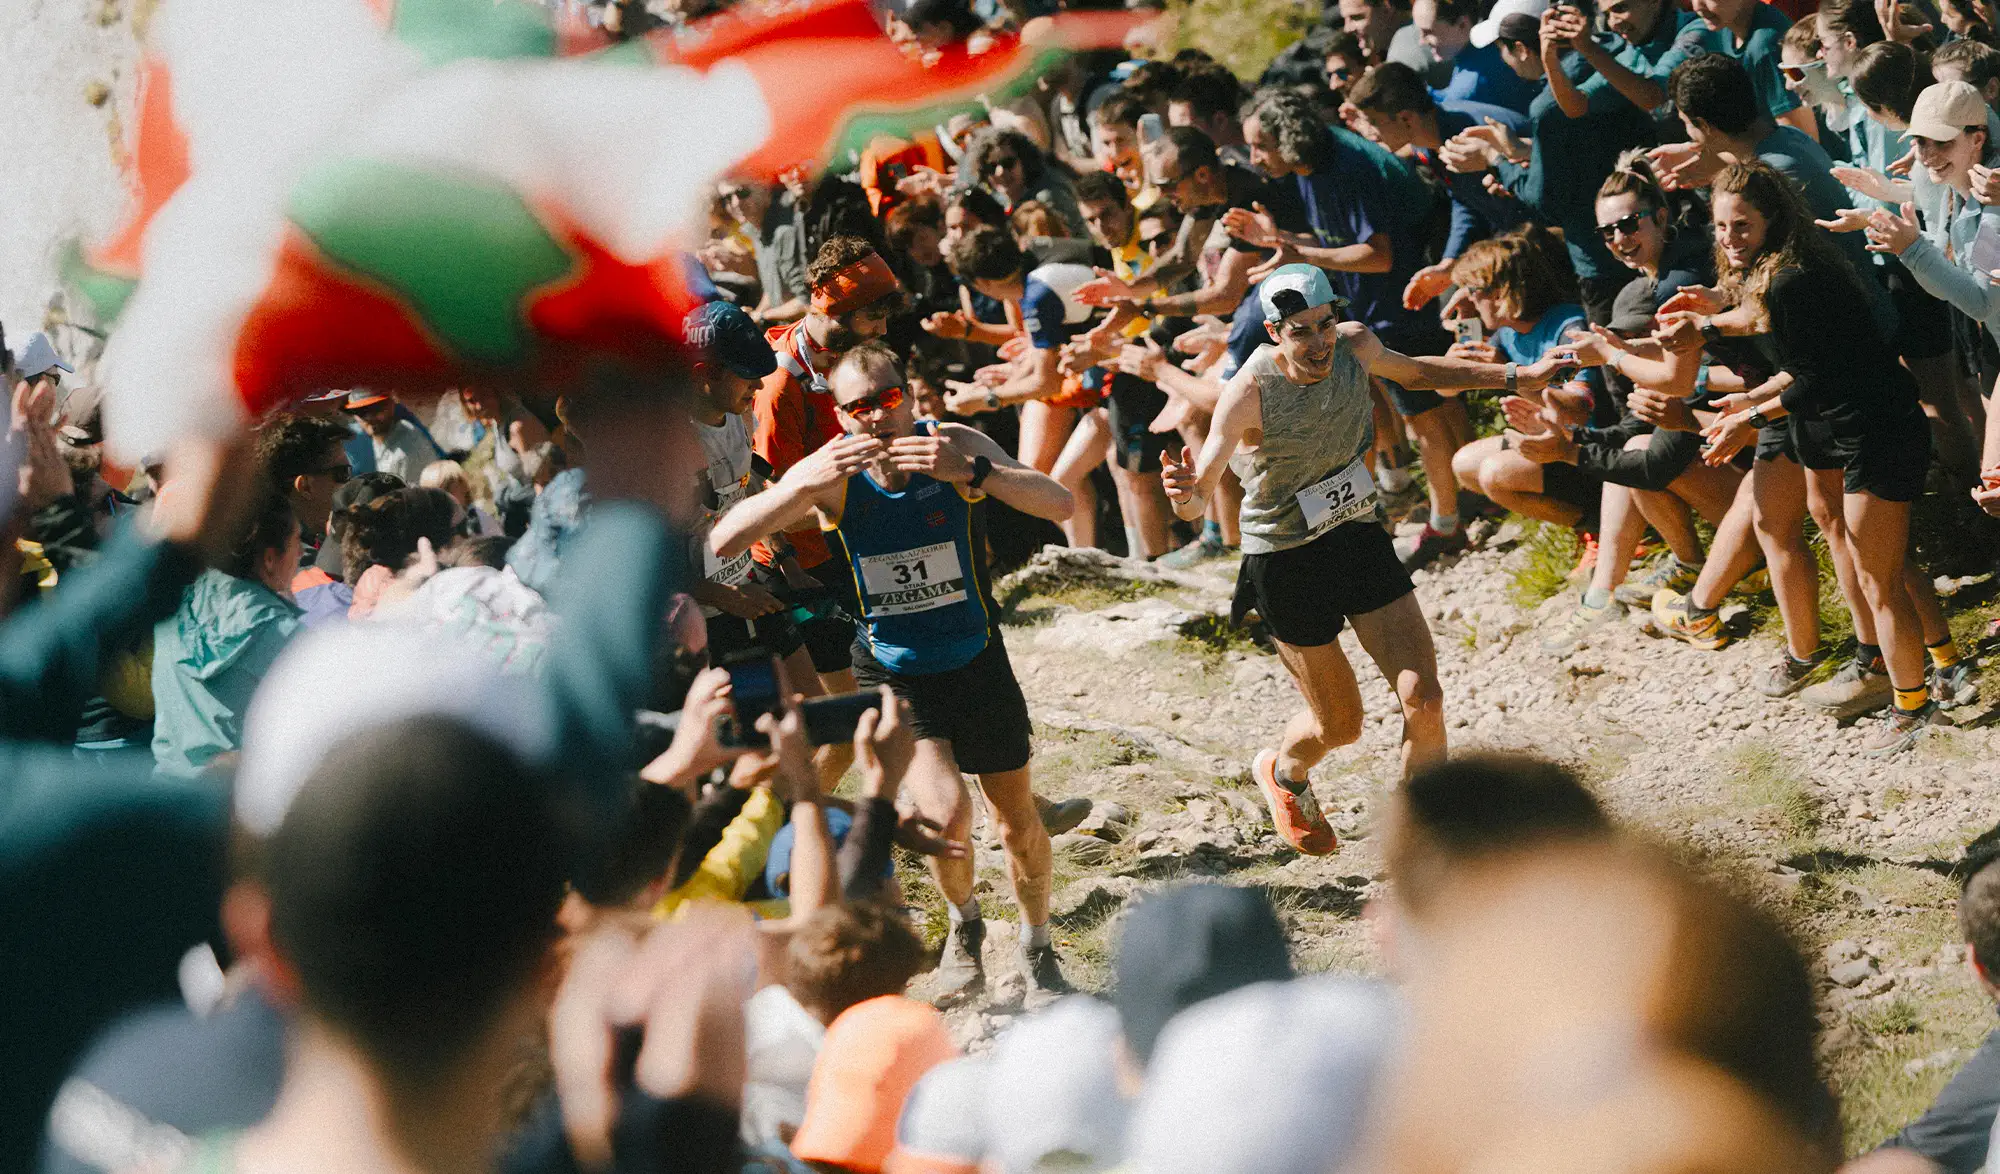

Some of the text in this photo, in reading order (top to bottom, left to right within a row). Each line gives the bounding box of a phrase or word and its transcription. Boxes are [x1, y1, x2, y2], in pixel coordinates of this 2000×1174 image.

[1326, 481, 1355, 510] 32
[1331, 499, 1356, 515] ANTONIO
[868, 543, 948, 564] ZEGAMA-AIZKORRI
[892, 560, 928, 584] 31
[880, 581, 955, 605] ZEGAMA
[903, 581, 926, 590] STIAN
